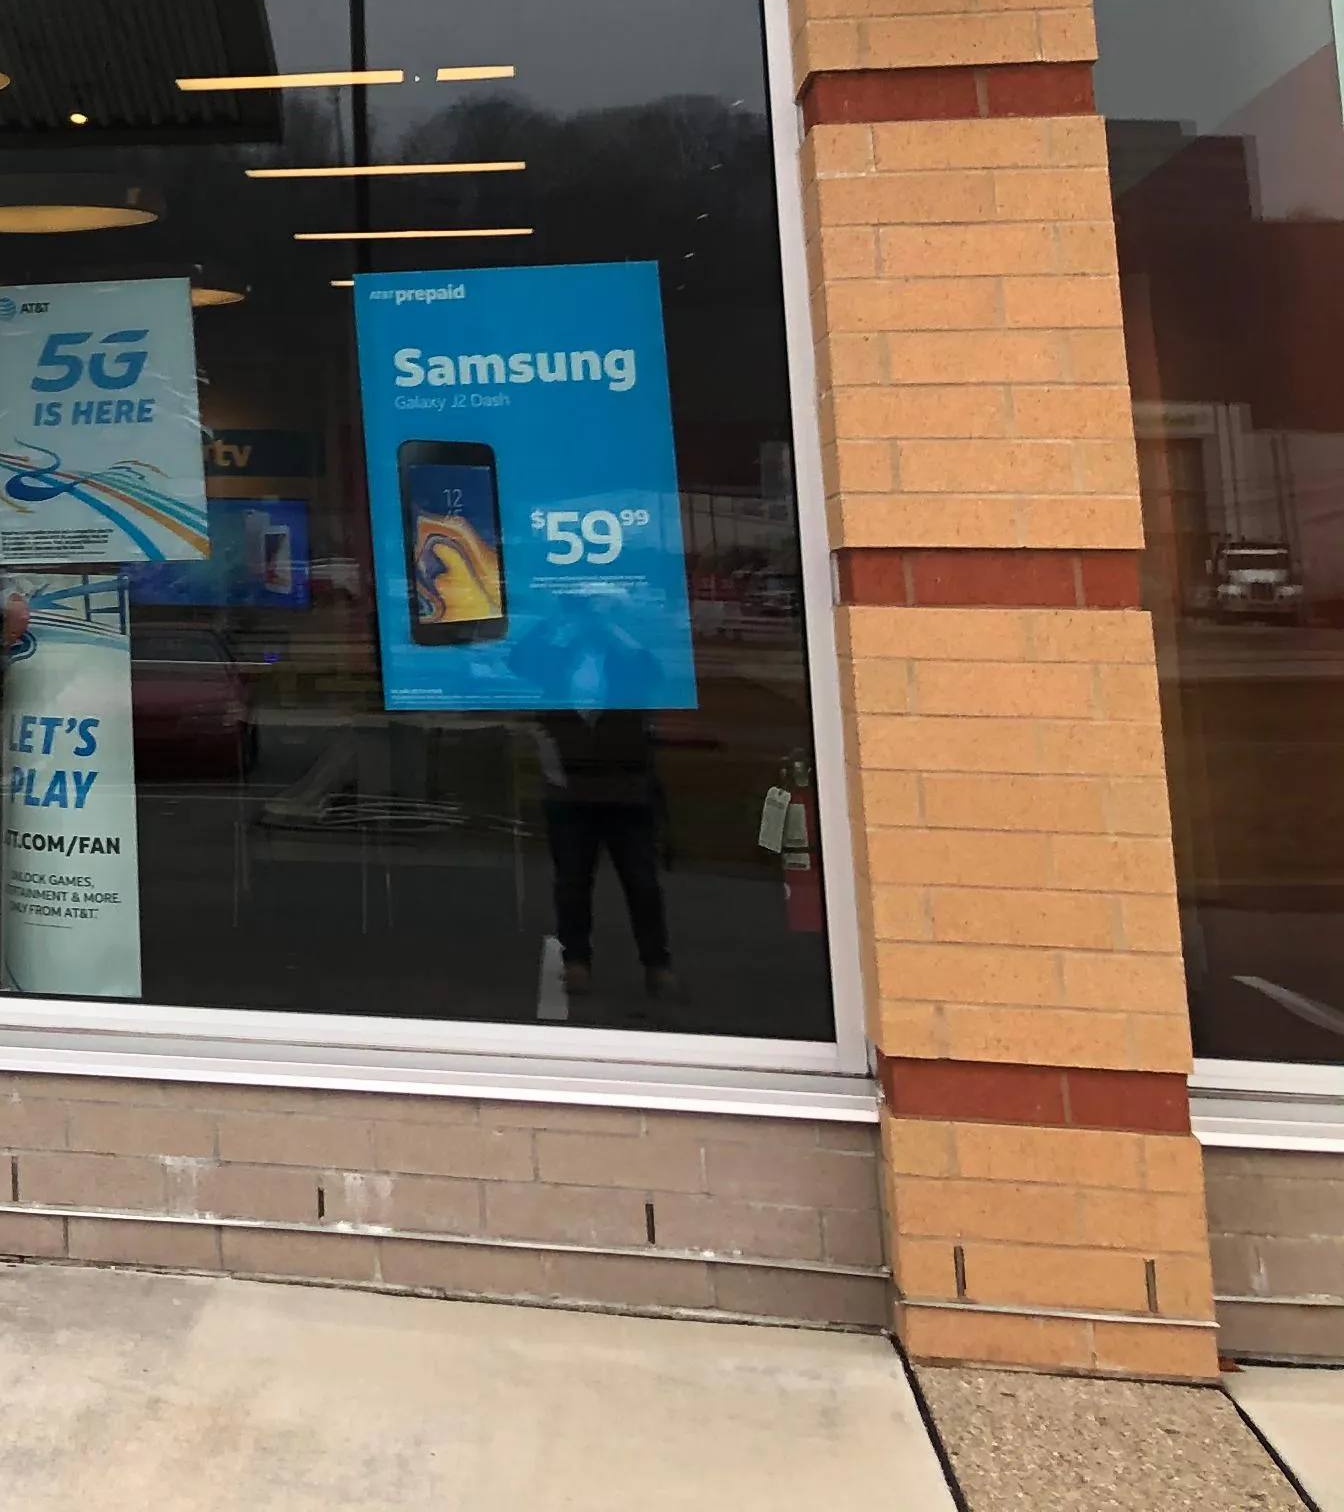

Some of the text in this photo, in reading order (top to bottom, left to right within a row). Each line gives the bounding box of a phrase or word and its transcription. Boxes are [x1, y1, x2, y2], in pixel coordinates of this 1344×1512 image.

[395, 284, 465, 305] prepaid
[20, 302, 50, 314] AT&T
[30, 329, 149, 393] 5G
[394, 347, 637, 392] Samsung
[395, 392, 510, 412] Galaxy J2 Dash
[33, 398, 155, 427] IS HERE
[11, 766, 99, 809] PLAY
[49, 874, 95, 888] GAMES,
[71, 892, 80, 903] &
[83, 892, 122, 904] MORE.
[29, 903, 61, 917] FROM
